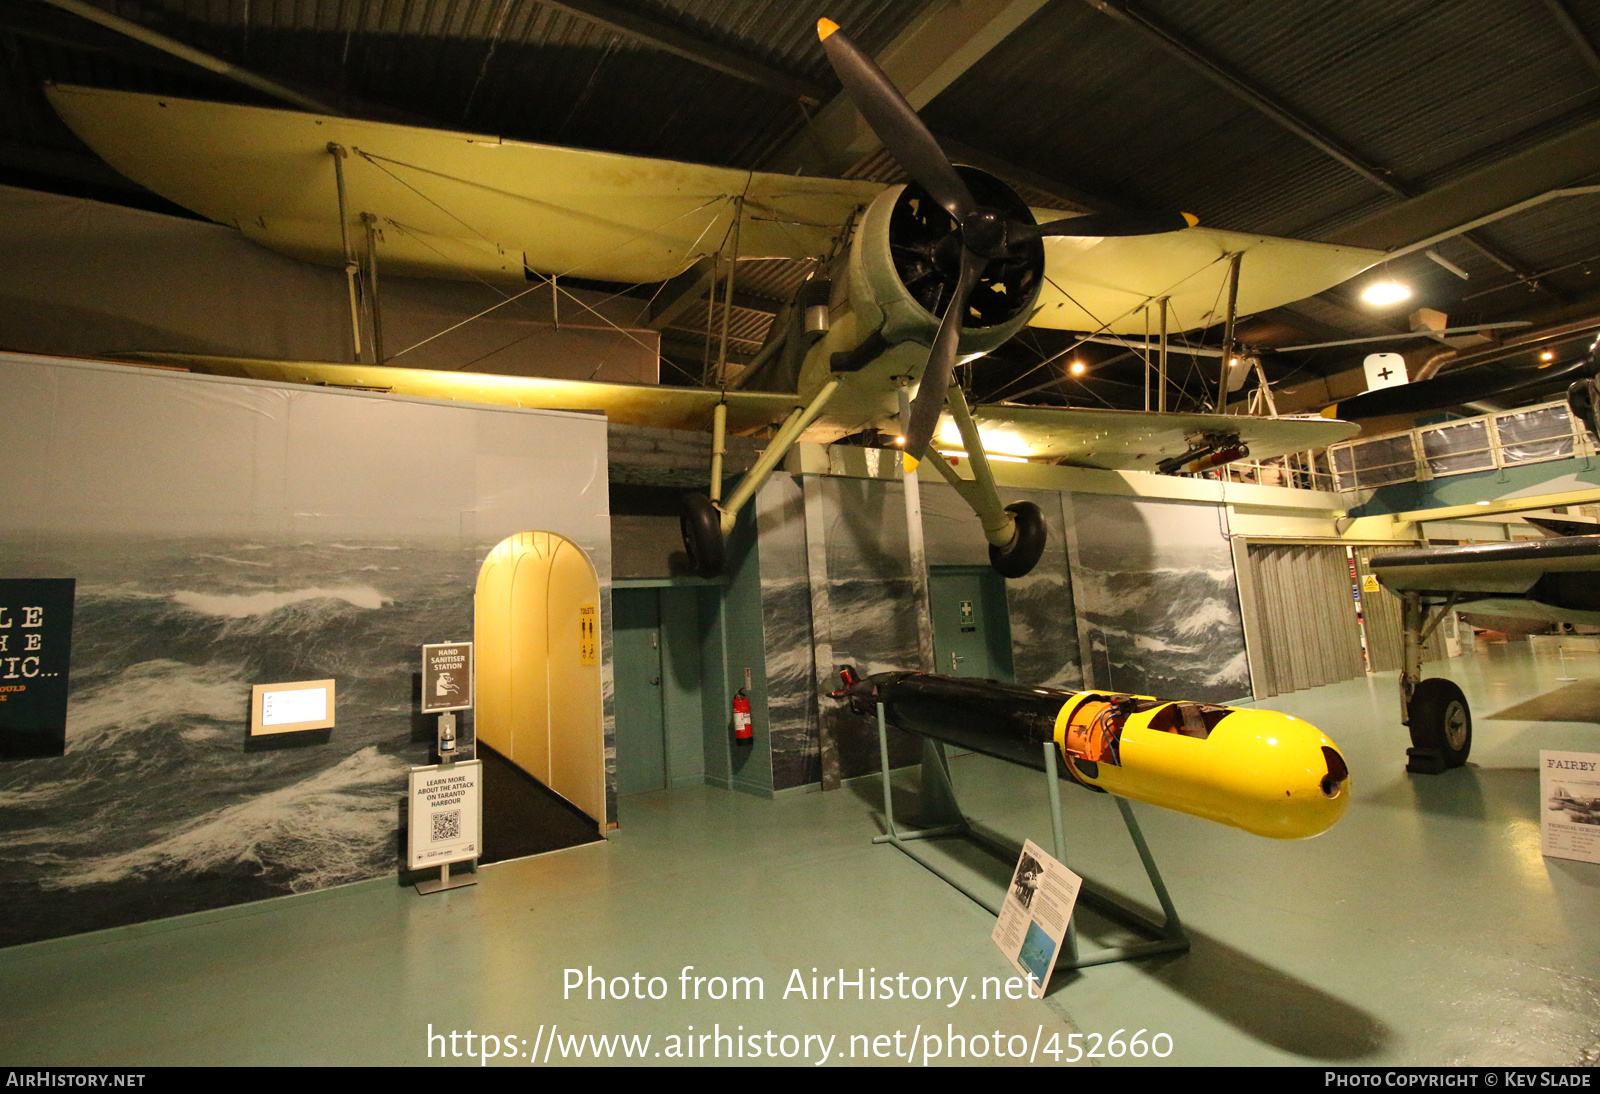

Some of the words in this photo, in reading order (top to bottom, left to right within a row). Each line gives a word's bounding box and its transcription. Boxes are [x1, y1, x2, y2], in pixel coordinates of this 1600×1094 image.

[438, 648, 458, 656] HAND
[430, 655, 465, 664] SANITISER
[434, 662, 463, 671] STATION
[1547, 758, 1597, 772] FAIREY
[426, 778, 447, 787] LEARN
[448, 775, 466, 784] MORE
[417, 786, 439, 795] ABOUT
[440, 784, 451, 792] THE
[452, 781, 474, 790] ATTACK
[437, 789, 466, 799] TARANTO
[431, 797, 461, 808] HARBOUR
